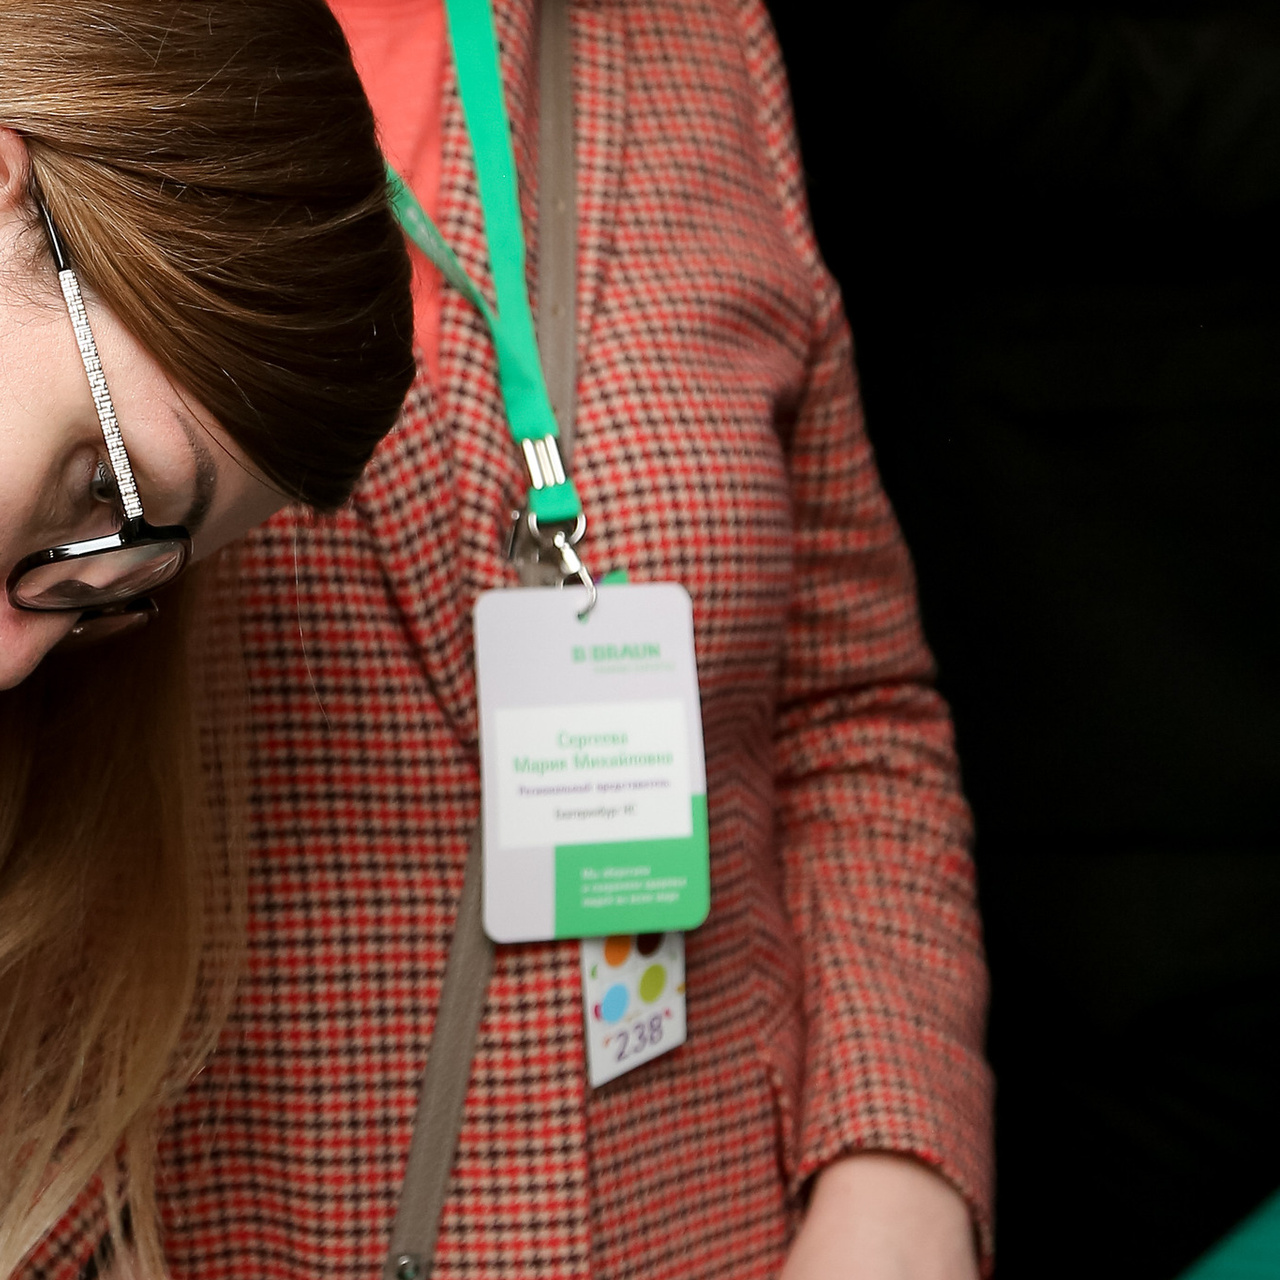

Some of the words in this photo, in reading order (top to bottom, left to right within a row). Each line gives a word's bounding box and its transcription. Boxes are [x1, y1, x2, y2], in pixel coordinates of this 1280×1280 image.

[591, 642, 661, 661] BRAUN
[557, 730, 628, 749] Сергеева
[513, 755, 568, 776] Мария
[572, 751, 674, 770] Михайловна
[615, 1013, 663, 1062] 238
